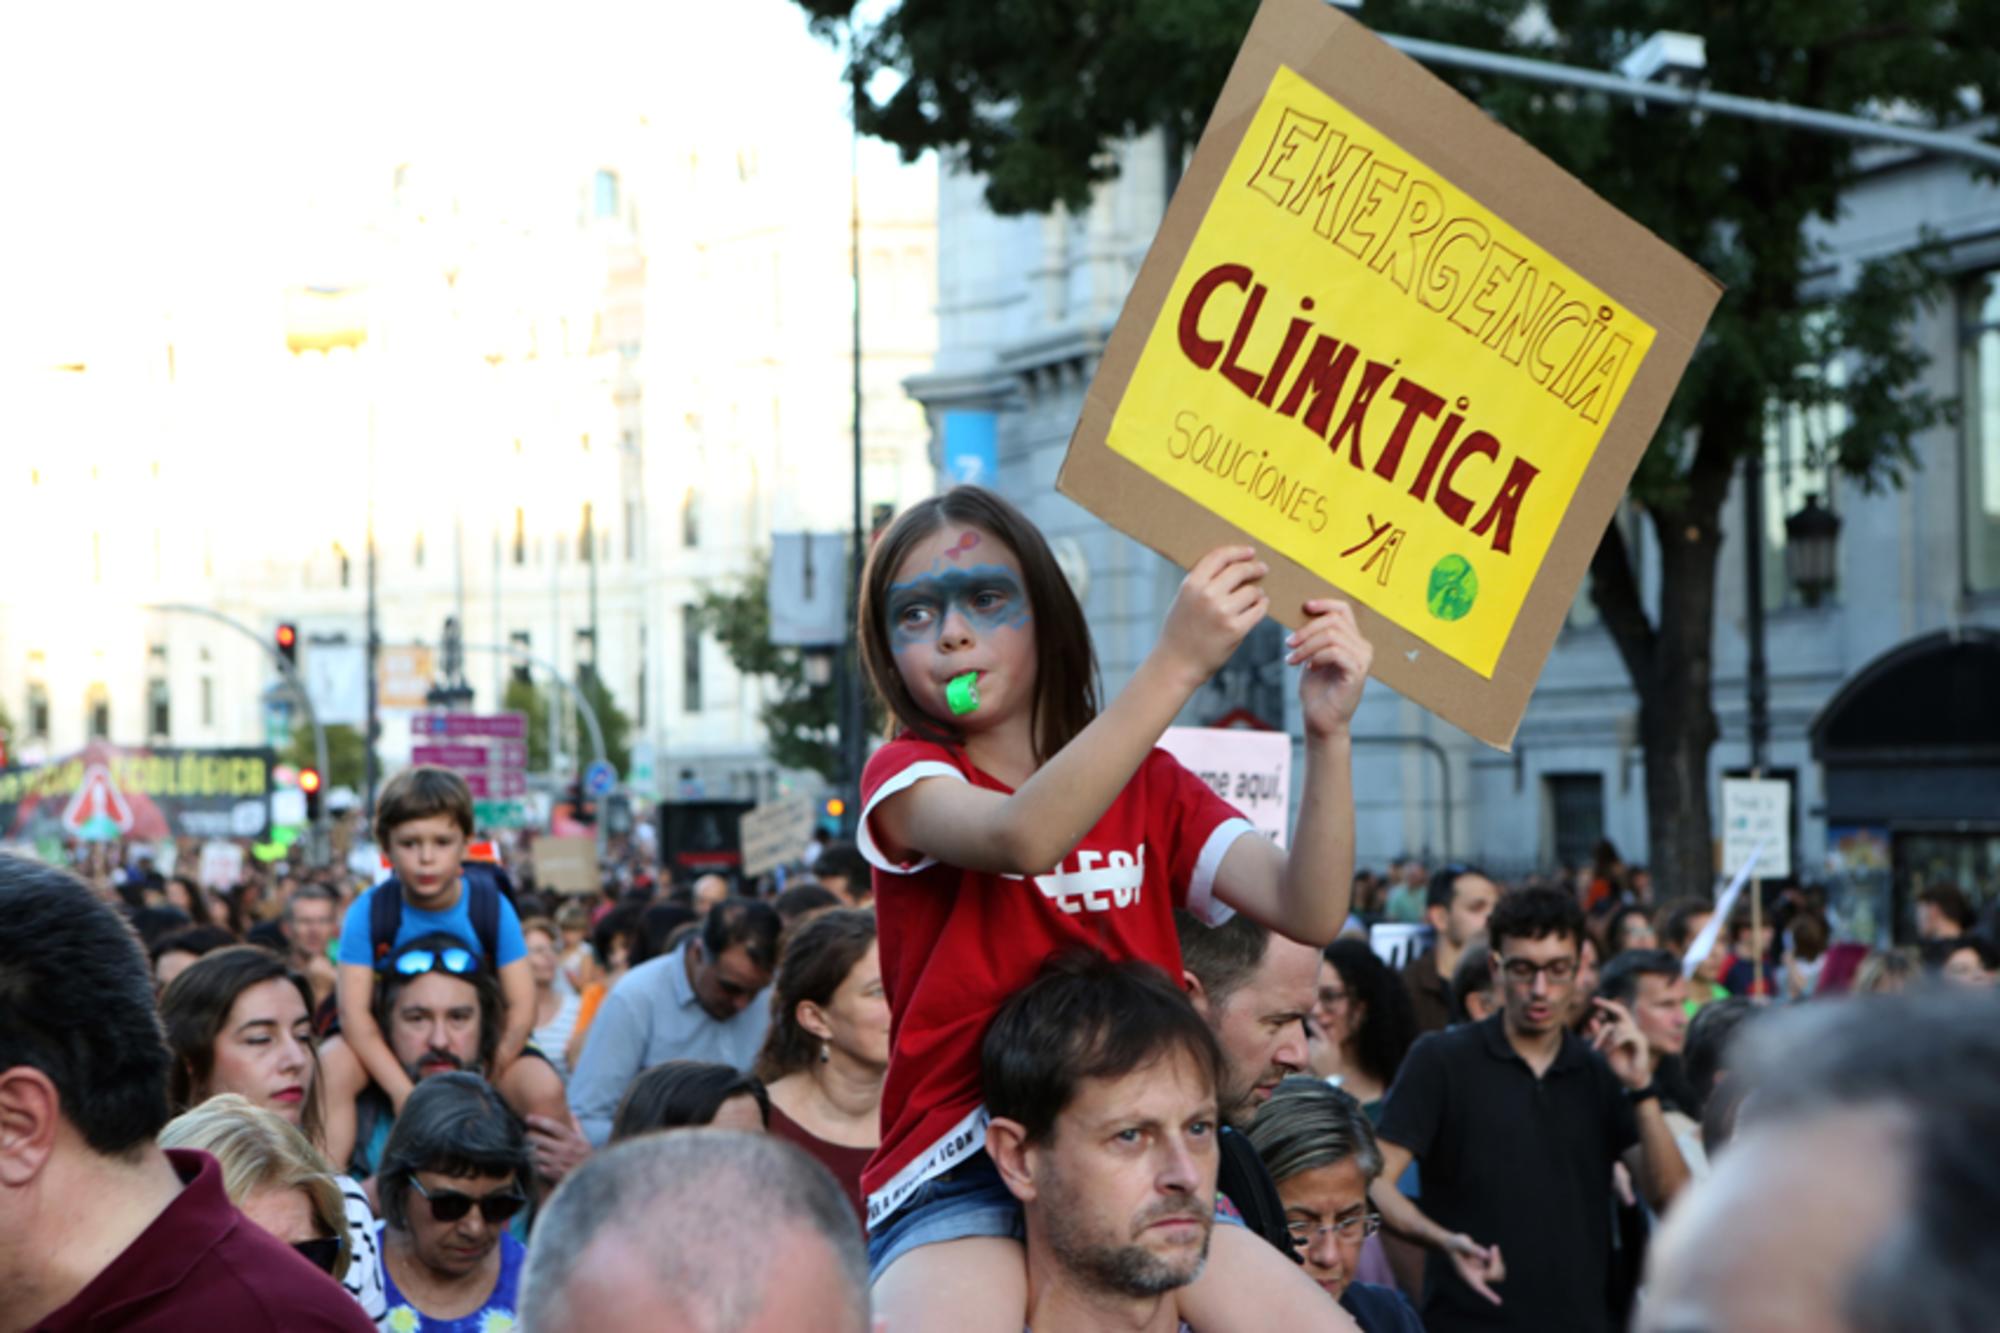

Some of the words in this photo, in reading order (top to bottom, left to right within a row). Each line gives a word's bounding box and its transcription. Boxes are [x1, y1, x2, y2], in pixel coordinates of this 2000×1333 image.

[1167, 410, 1329, 533] SOLUCIONES
[1340, 513, 1406, 587] YA
[1235, 763, 1283, 808] aquí,
[939, 1130, 974, 1162] ICON
